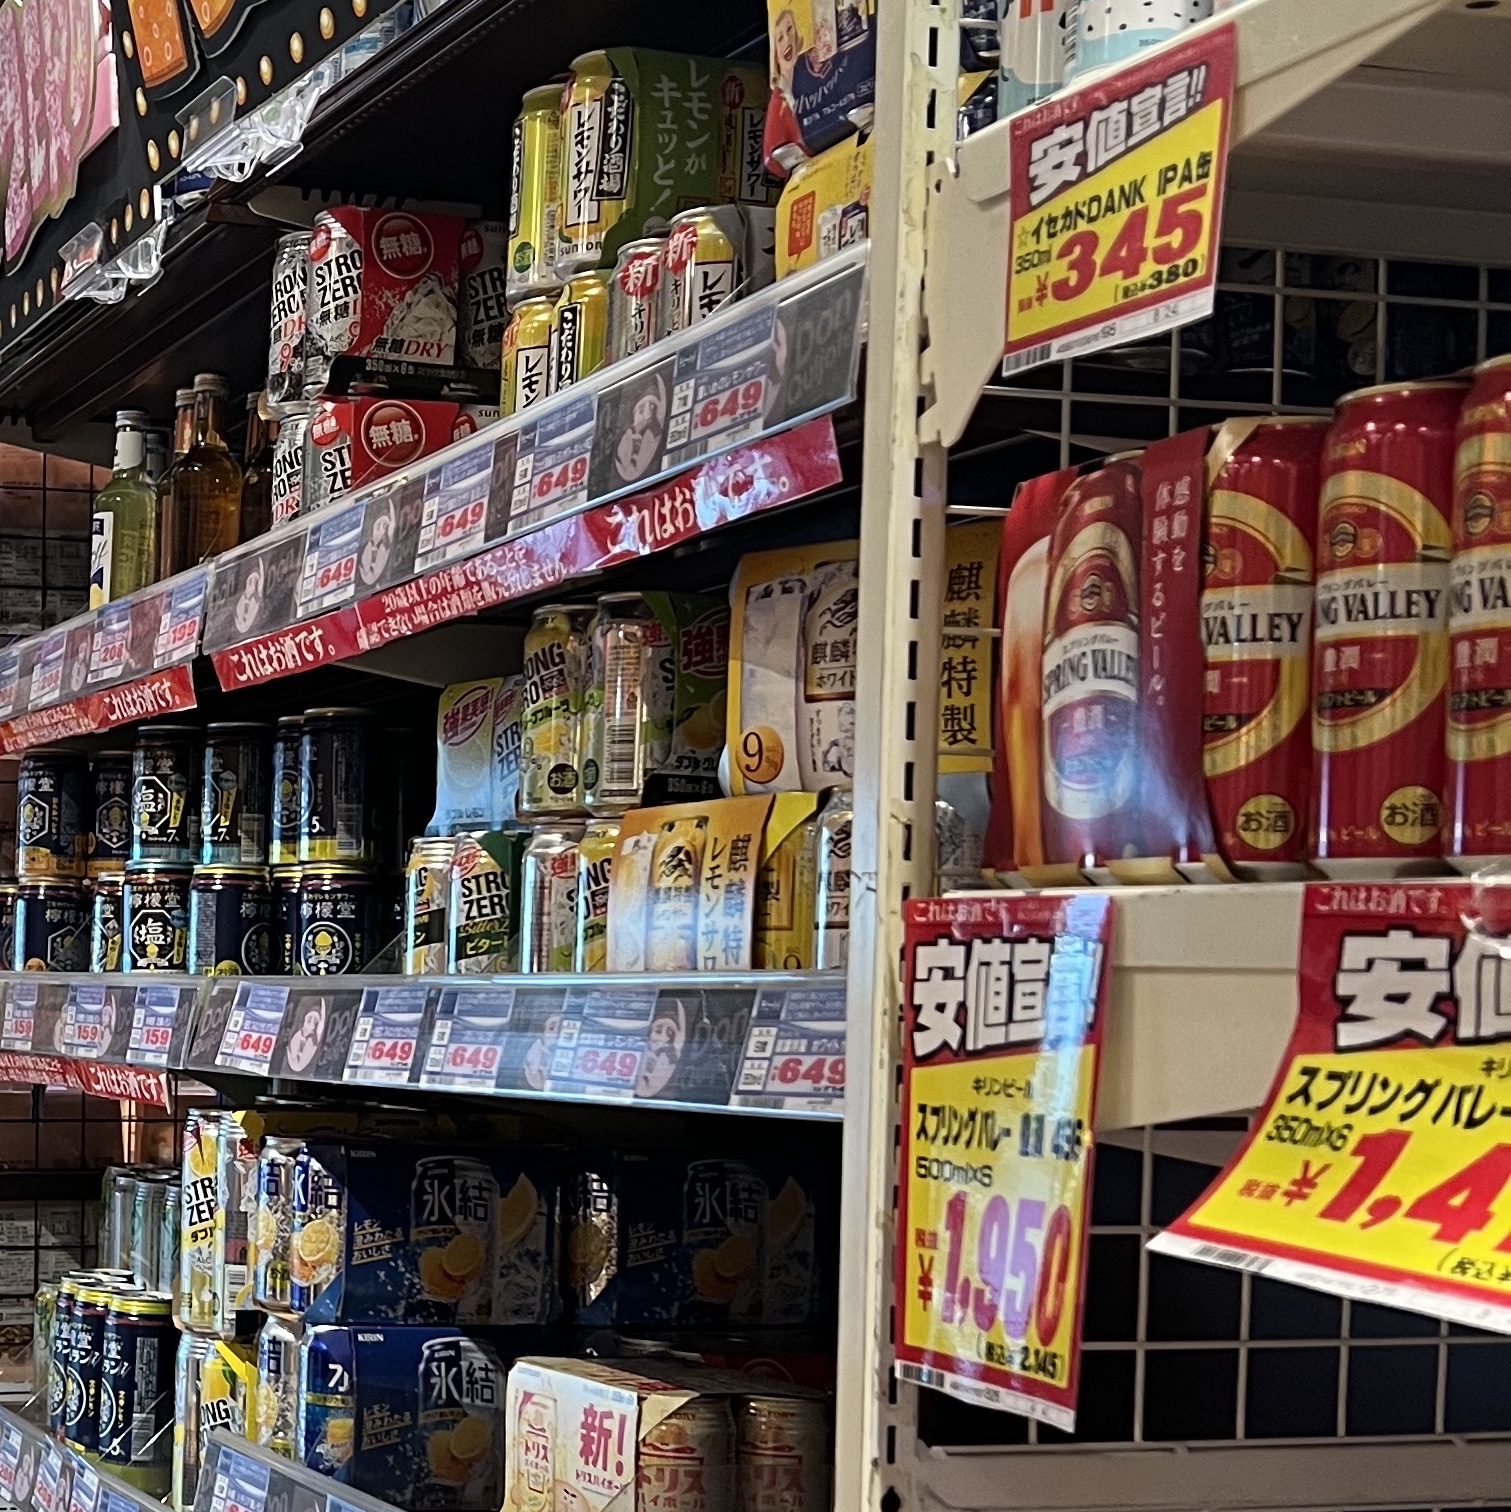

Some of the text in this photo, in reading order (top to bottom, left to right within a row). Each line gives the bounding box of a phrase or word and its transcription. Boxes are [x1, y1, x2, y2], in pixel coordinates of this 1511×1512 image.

[684, 60, 712, 174] レモンが
[1029, 63, 1210, 206] 安値宣言!!
[599, 81, 625, 195] こだわり酒場
[571, 105, 595, 220] レモンサワー
[667, 226, 698, 265] 新
[1052, 185, 1207, 303] 345
[624, 253, 658, 294] 新
[404, 341, 451, 359] DRY
[698, 380, 762, 428] 649
[532, 457, 587, 500] 649
[1343, 588, 1443, 623] VALLEY
[1203, 611, 1305, 647] VALLEY
[229, 624, 337, 683] これはお酒です。
[941, 562, 986, 745] 麒麟特製
[104, 678, 181, 721] これはお酒です。
[1238, 808, 1291, 833] お酒
[1382, 800, 1438, 830] お酒
[140, 920, 163, 945] 塩
[371, 1040, 413, 1063] 649
[449, 1046, 498, 1069] 649
[580, 1050, 638, 1077] 649
[430, 1364, 498, 1406] 氷結
[524, 1442, 549, 1463] トリス
[580, 1404, 628, 1477] 新!
